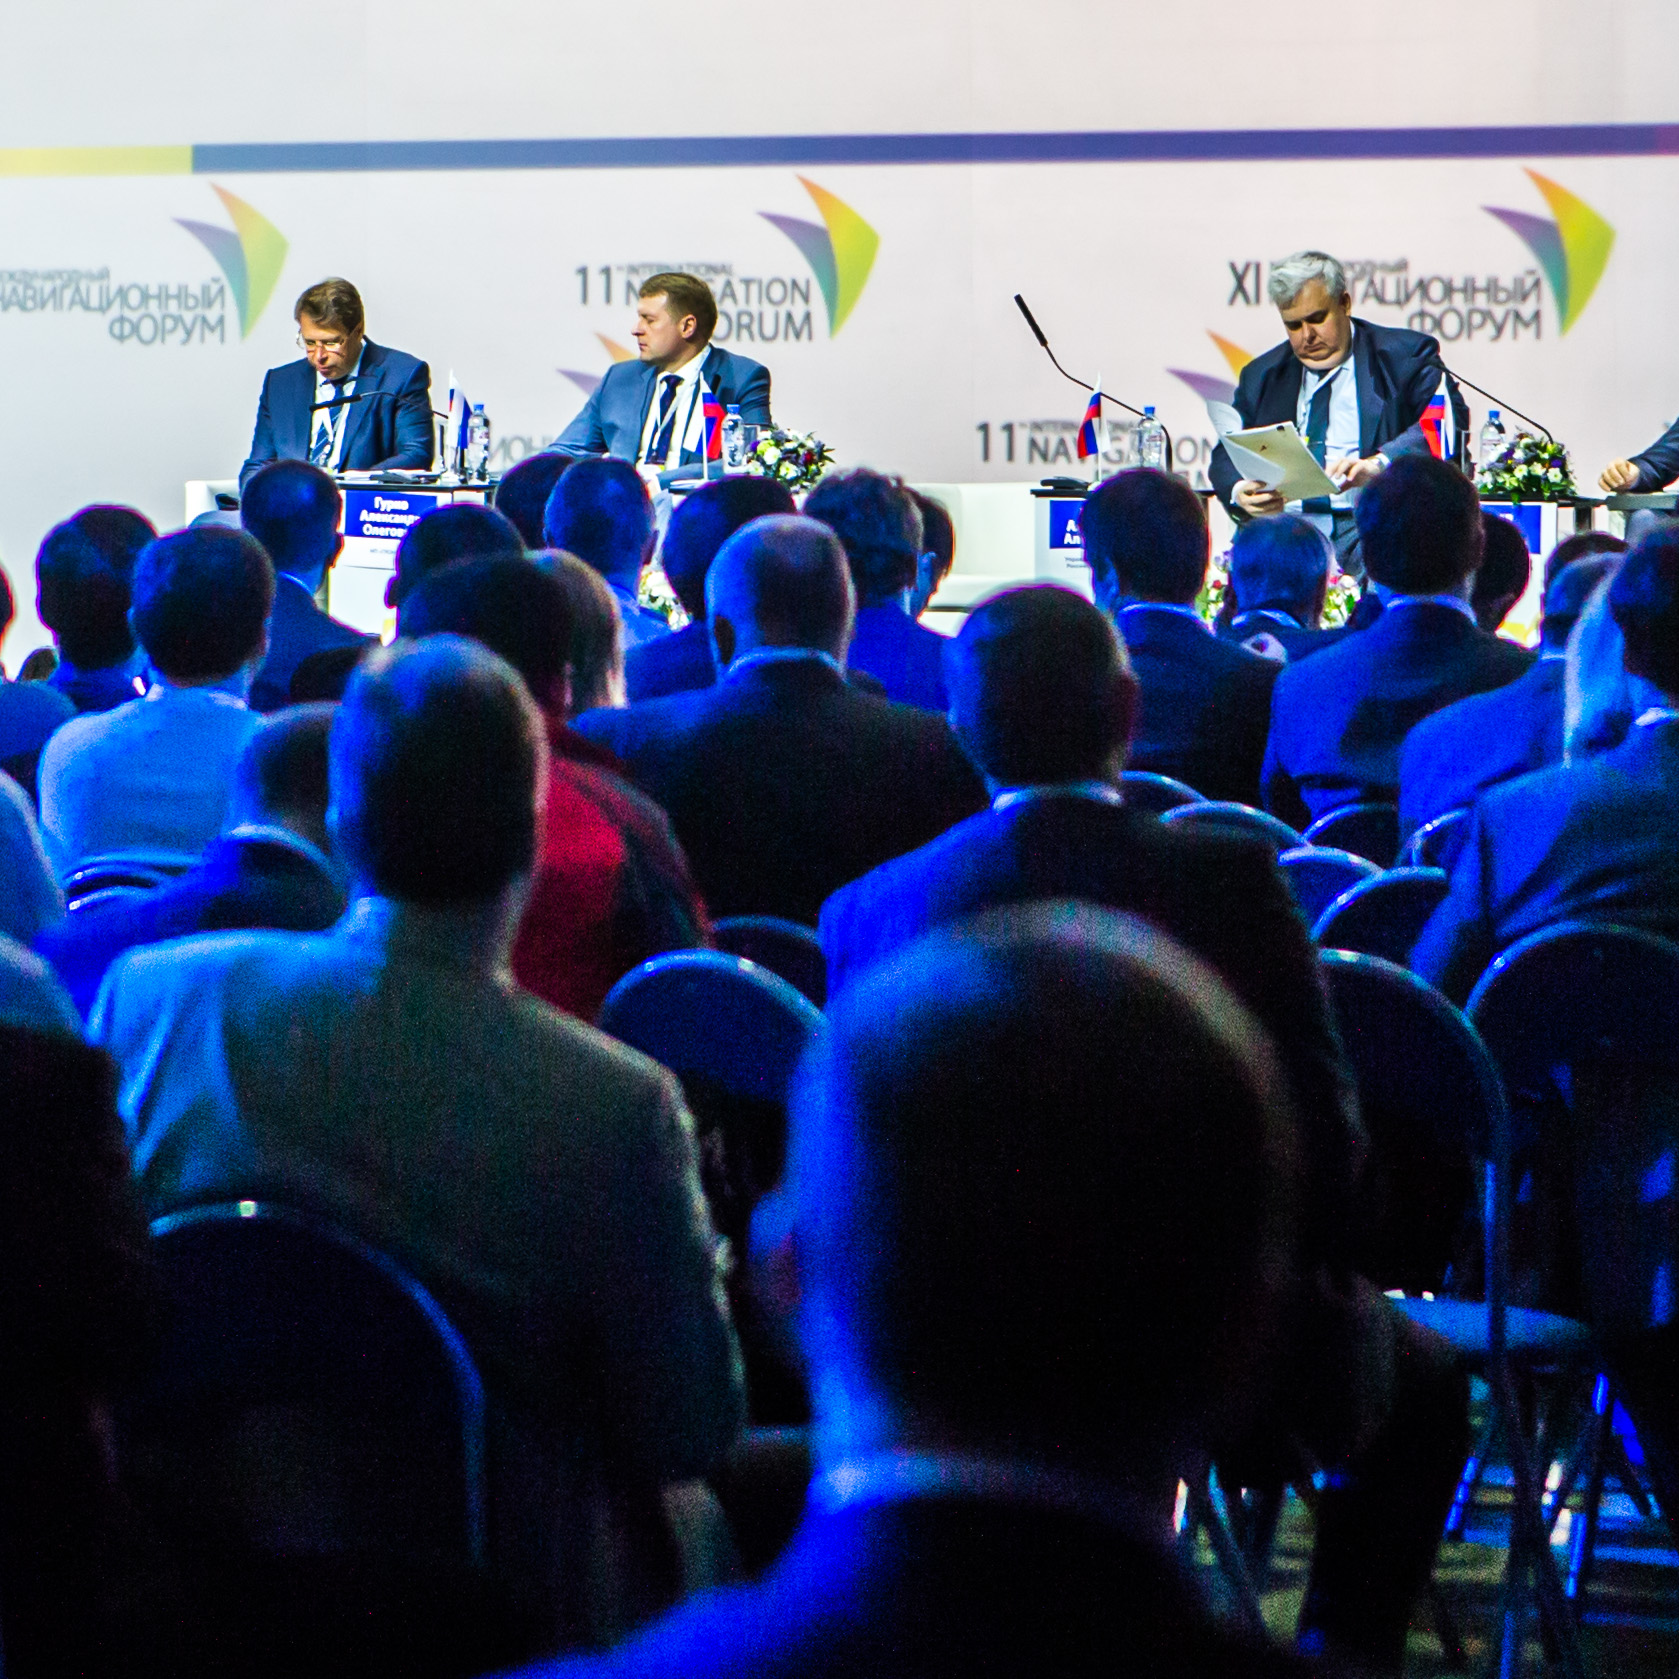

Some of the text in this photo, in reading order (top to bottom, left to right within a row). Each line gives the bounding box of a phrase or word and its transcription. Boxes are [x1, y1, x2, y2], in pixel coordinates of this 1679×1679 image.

[1228, 260, 1261, 307] XI
[109, 313, 226, 345] ФОРУМ
[712, 309, 813, 343] ORUM
[1408, 307, 1542, 342] ФОРУМ
